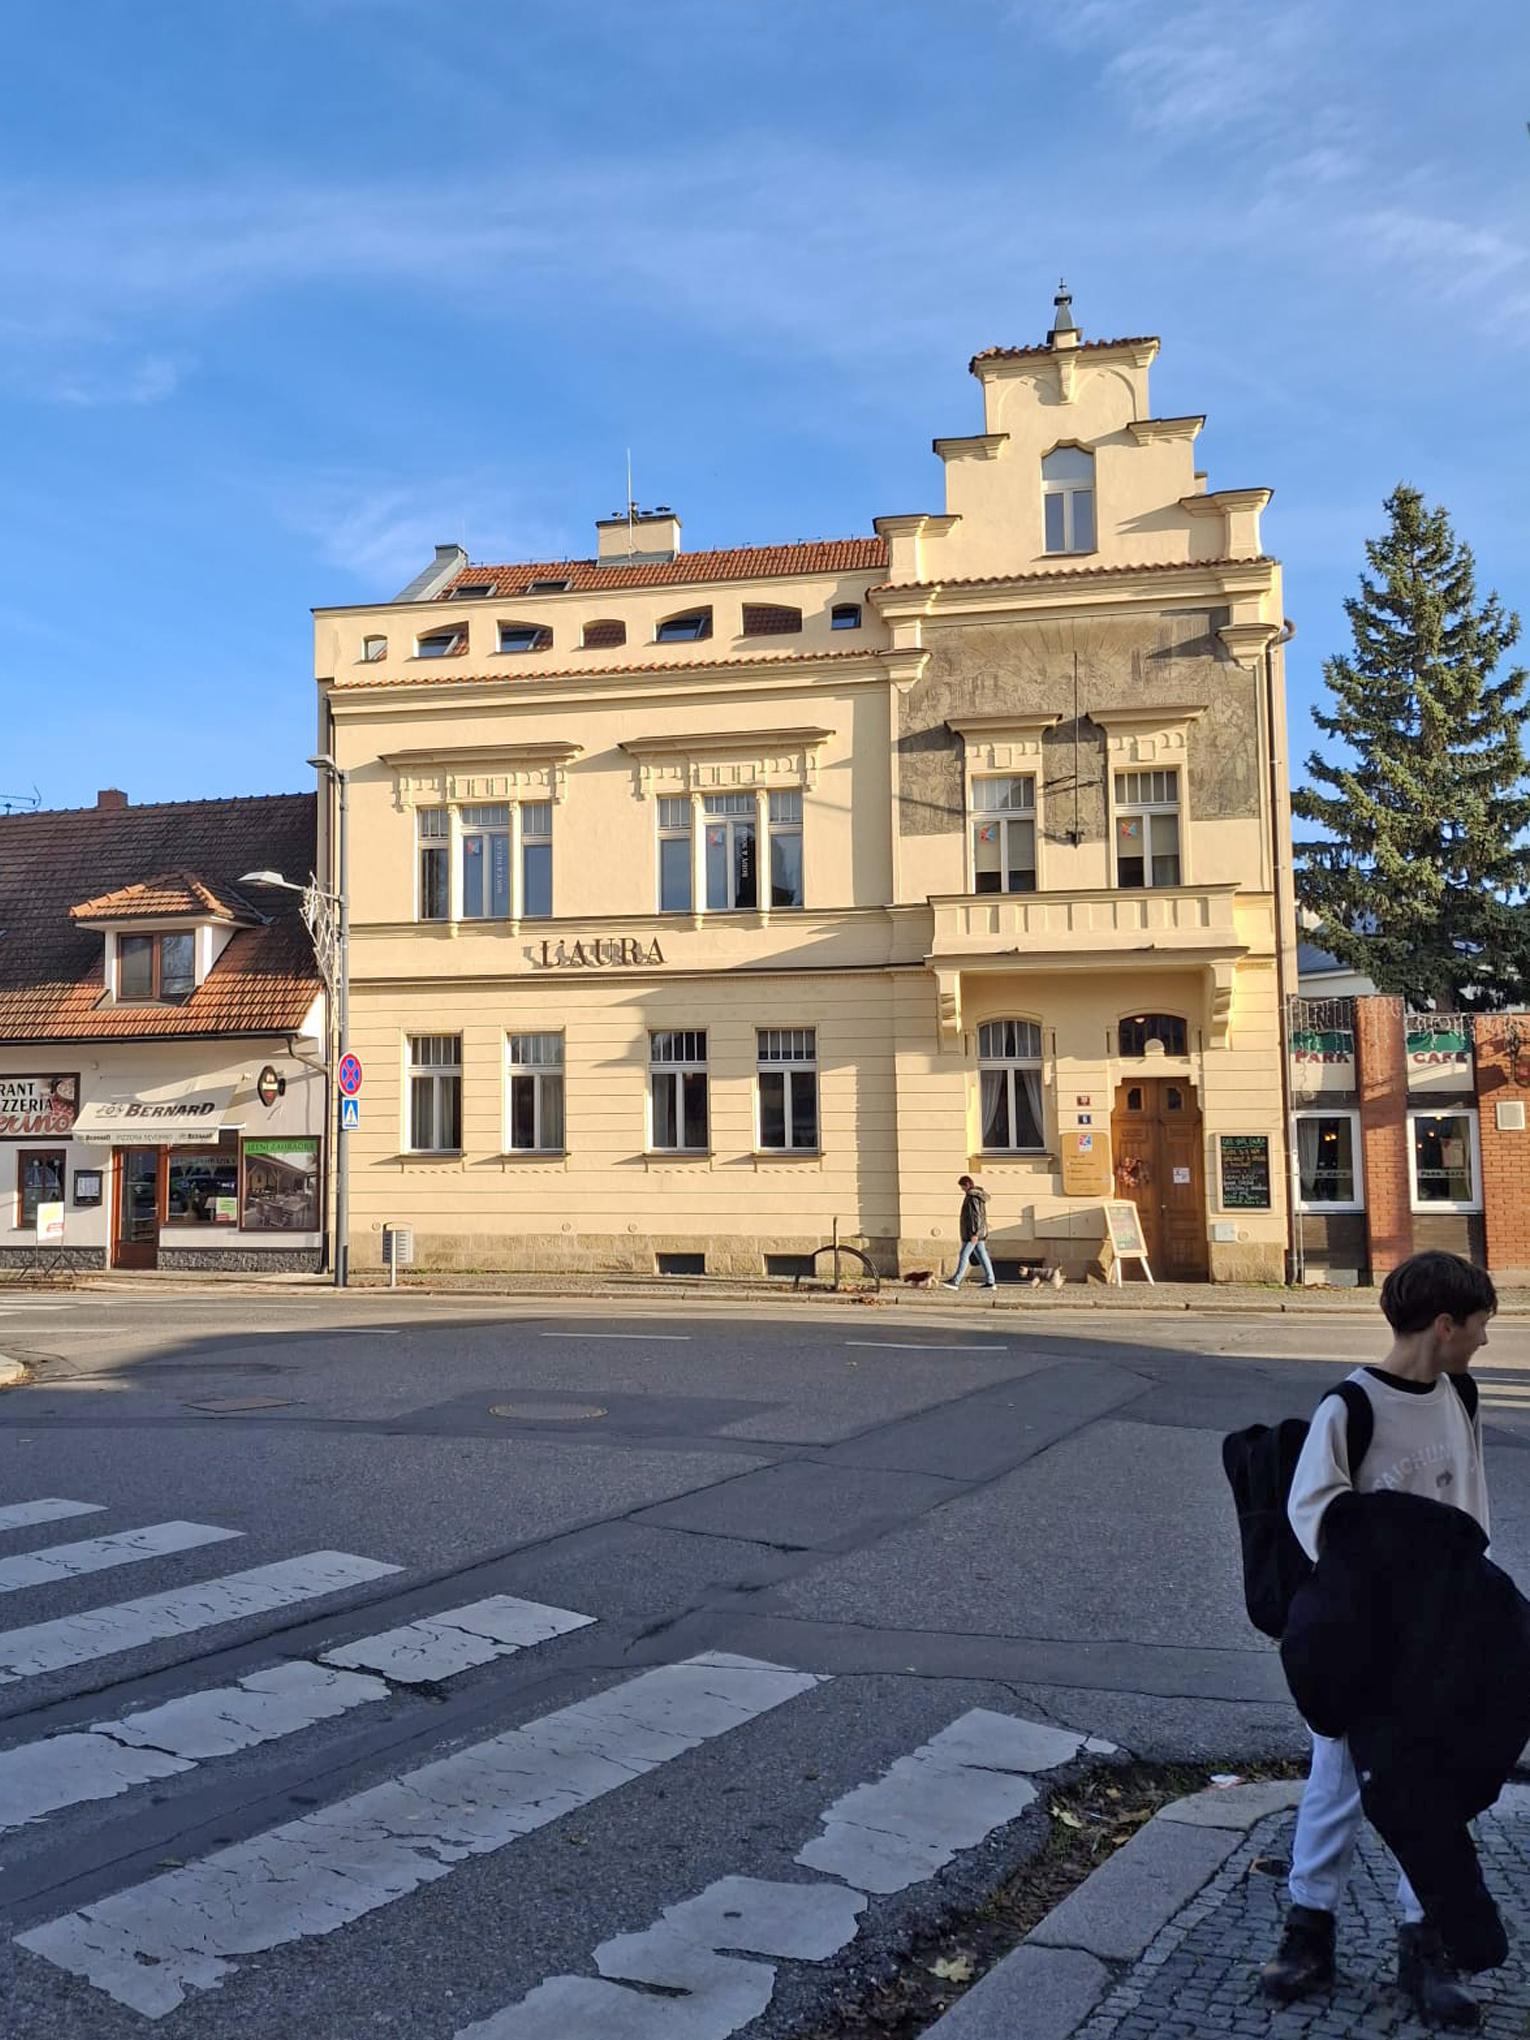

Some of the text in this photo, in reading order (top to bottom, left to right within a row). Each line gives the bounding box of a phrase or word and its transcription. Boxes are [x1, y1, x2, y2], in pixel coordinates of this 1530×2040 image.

[540, 936, 667, 967] L'AURA
[1295, 1049, 1350, 1064] PARK
[125, 1102, 215, 1118] BERNARD
